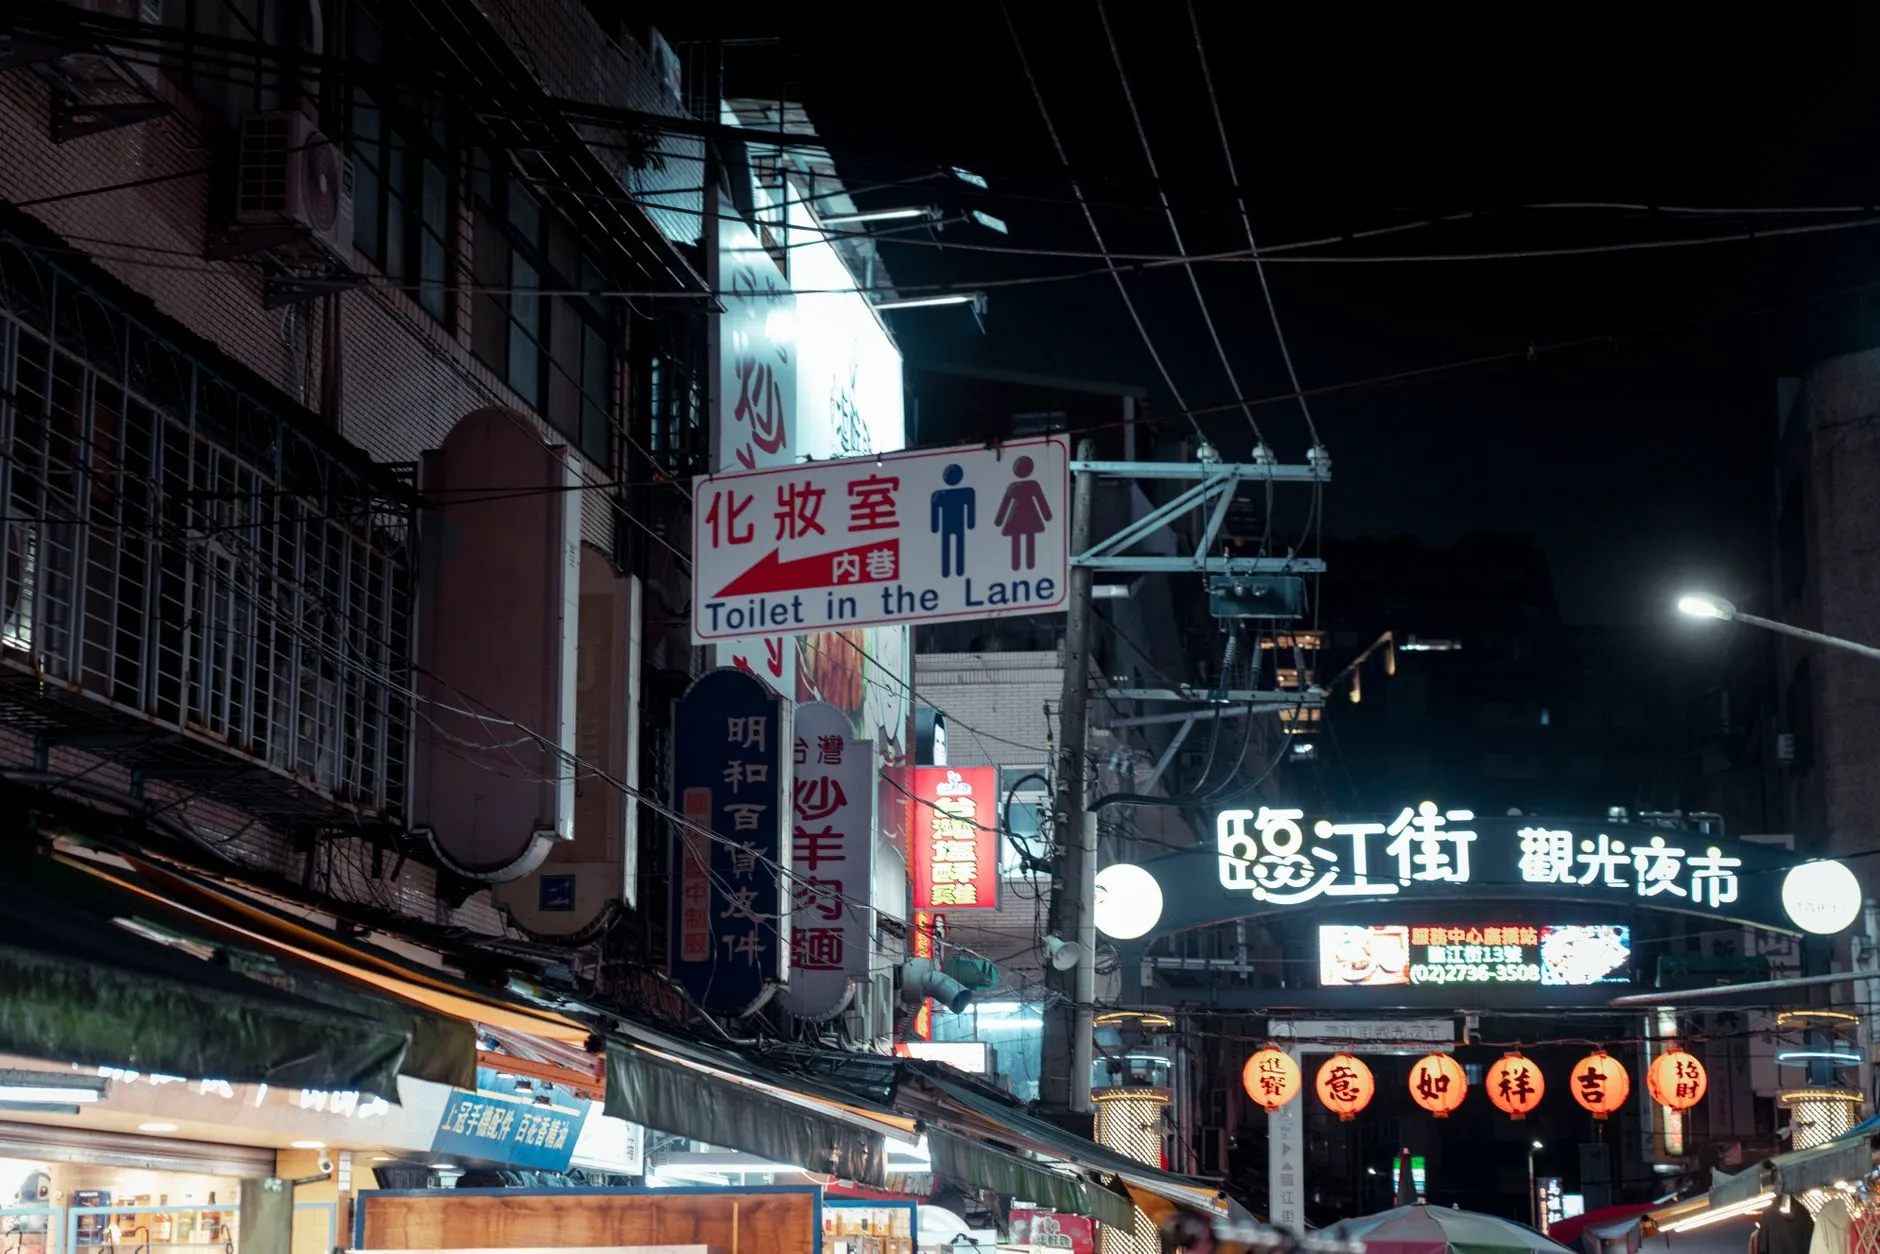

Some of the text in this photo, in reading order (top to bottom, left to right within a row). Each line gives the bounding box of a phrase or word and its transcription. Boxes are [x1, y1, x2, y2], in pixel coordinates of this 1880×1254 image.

[705, 473, 900, 549] 化妝室
[832, 548, 896, 584] 內巷
[705, 577, 1056, 632] Toilet in the Lane
[794, 735, 844, 765] 台灣
[720, 716, 768, 967] 明和百貨皮件
[1216, 801, 1743, 908] 臨江街 觀光夜市
[1324, 1066, 1360, 1102] 意
[1417, 1066, 1451, 1101] 如
[1498, 1066, 1535, 1104] 祥
[1577, 1066, 1608, 1104] 吉
[1675, 1060, 1700, 1100] 招財
